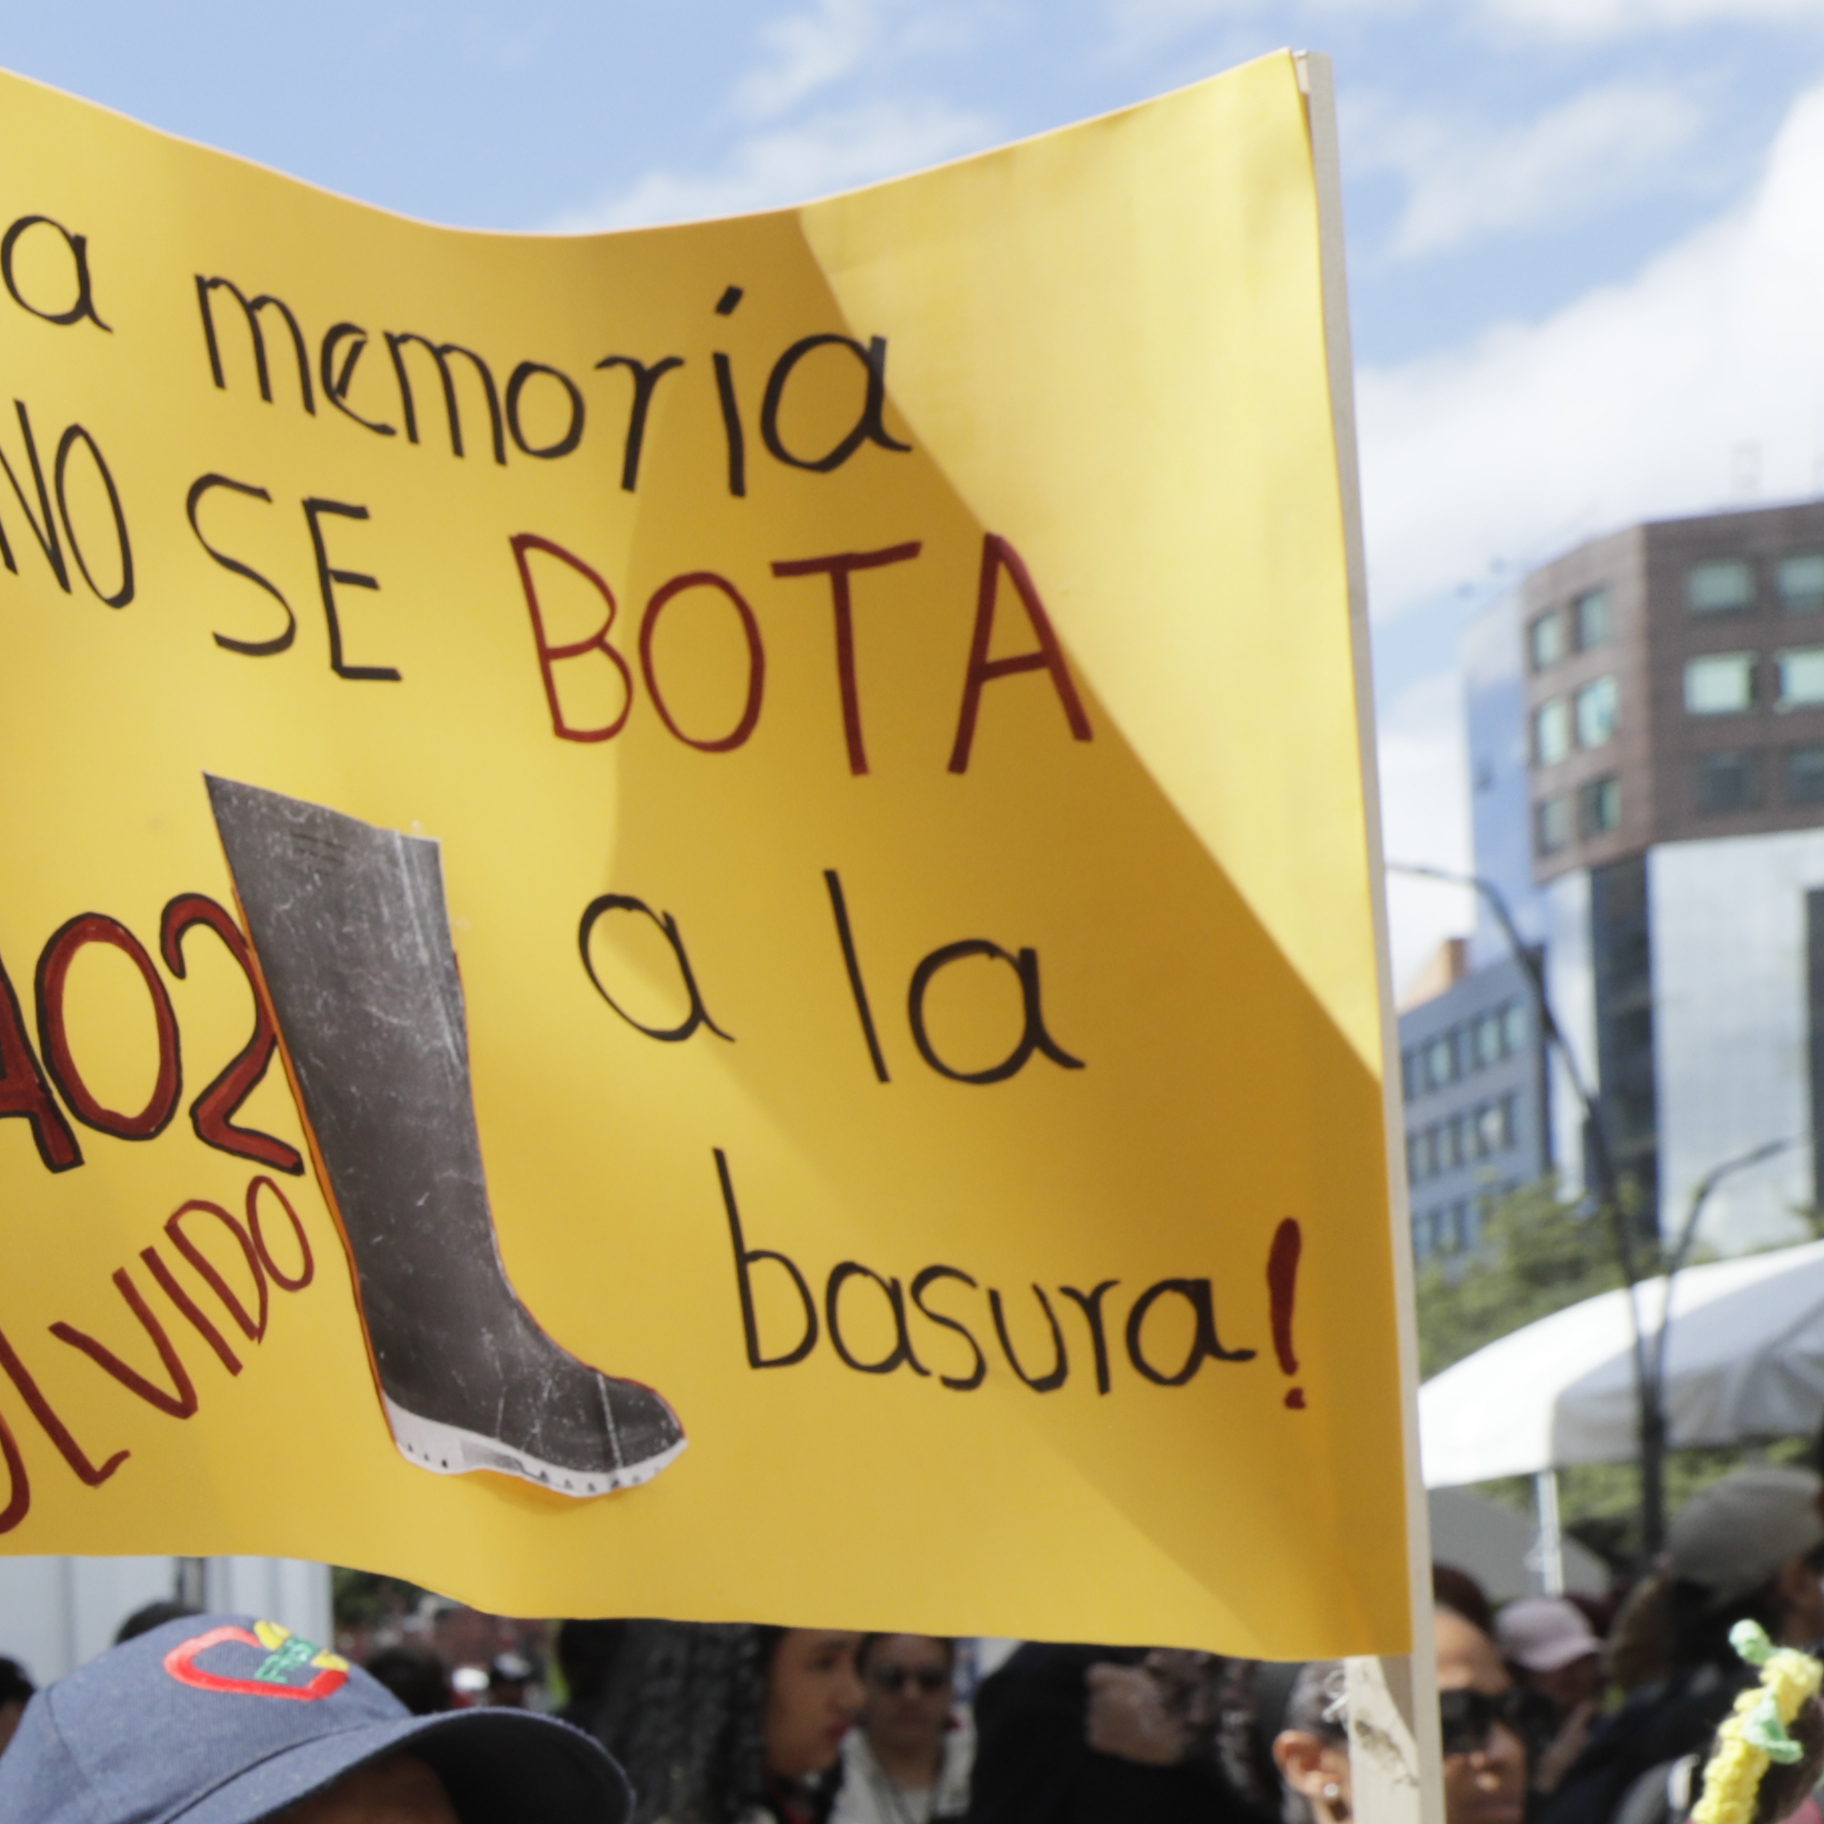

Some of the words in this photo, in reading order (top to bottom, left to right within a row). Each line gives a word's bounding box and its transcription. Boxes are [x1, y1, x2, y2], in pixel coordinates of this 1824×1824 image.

[194, 273, 913, 497] memoria
[185, 472, 403, 682] SE
[509, 531, 1095, 776] BOTA
[577, 892, 736, 1045] a
[822, 869, 1088, 1087] la
[713, 1147, 1310, 1410] basura!
